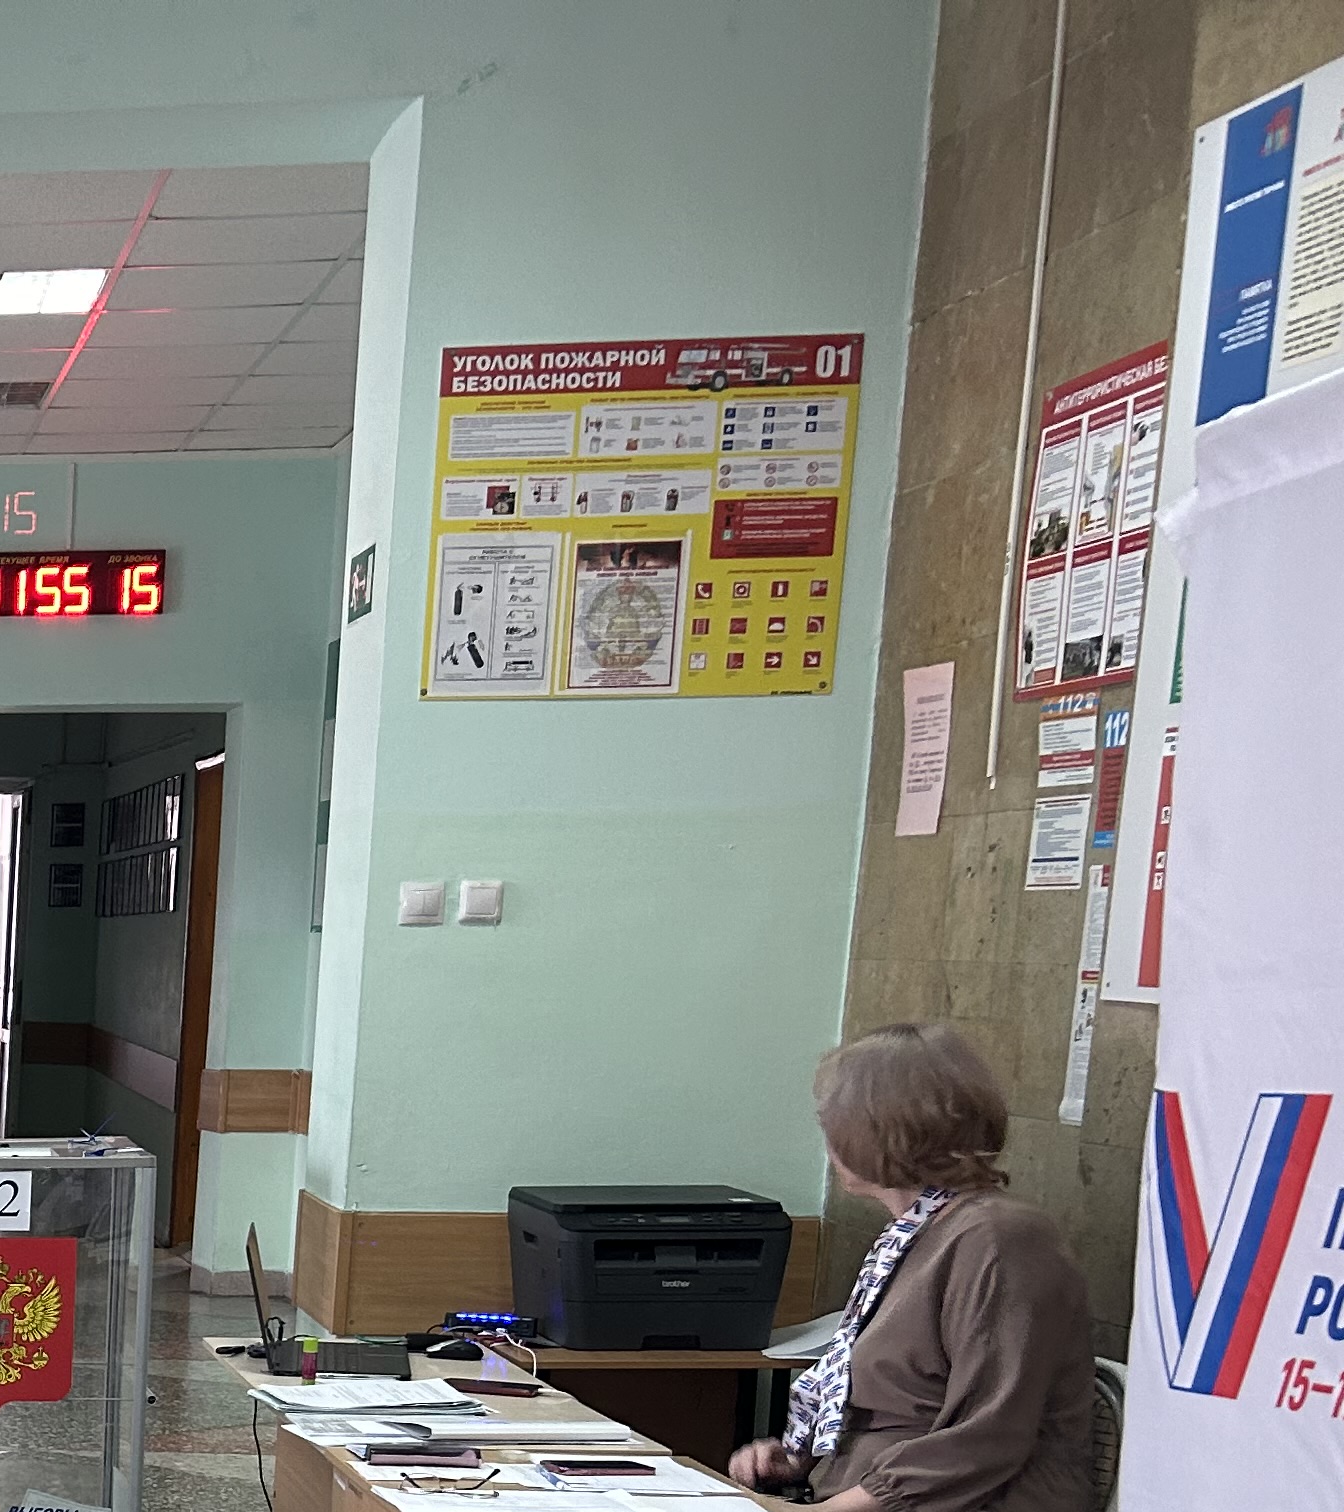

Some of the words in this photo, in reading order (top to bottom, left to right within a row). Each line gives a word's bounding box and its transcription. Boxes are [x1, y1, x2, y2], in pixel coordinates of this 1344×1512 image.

[452, 353, 534, 373] УГОЛОК
[540, 344, 666, 370] ПОЖАРНОЙ
[815, 344, 852, 379] 01
[451, 371, 622, 393] БЕЗОПАСНОСТИ
[3, 491, 37, 535] 15
[39, 555, 70, 565] ВРЕМЯ
[107, 555, 122, 565] ДО
[123, 554, 158, 563] ЗВОНКА
[120, 562, 160, 616] 15
[1058, 692, 1085, 715] 112
[1104, 711, 1130, 748] 112
[661, 1280, 691, 1288] brother
